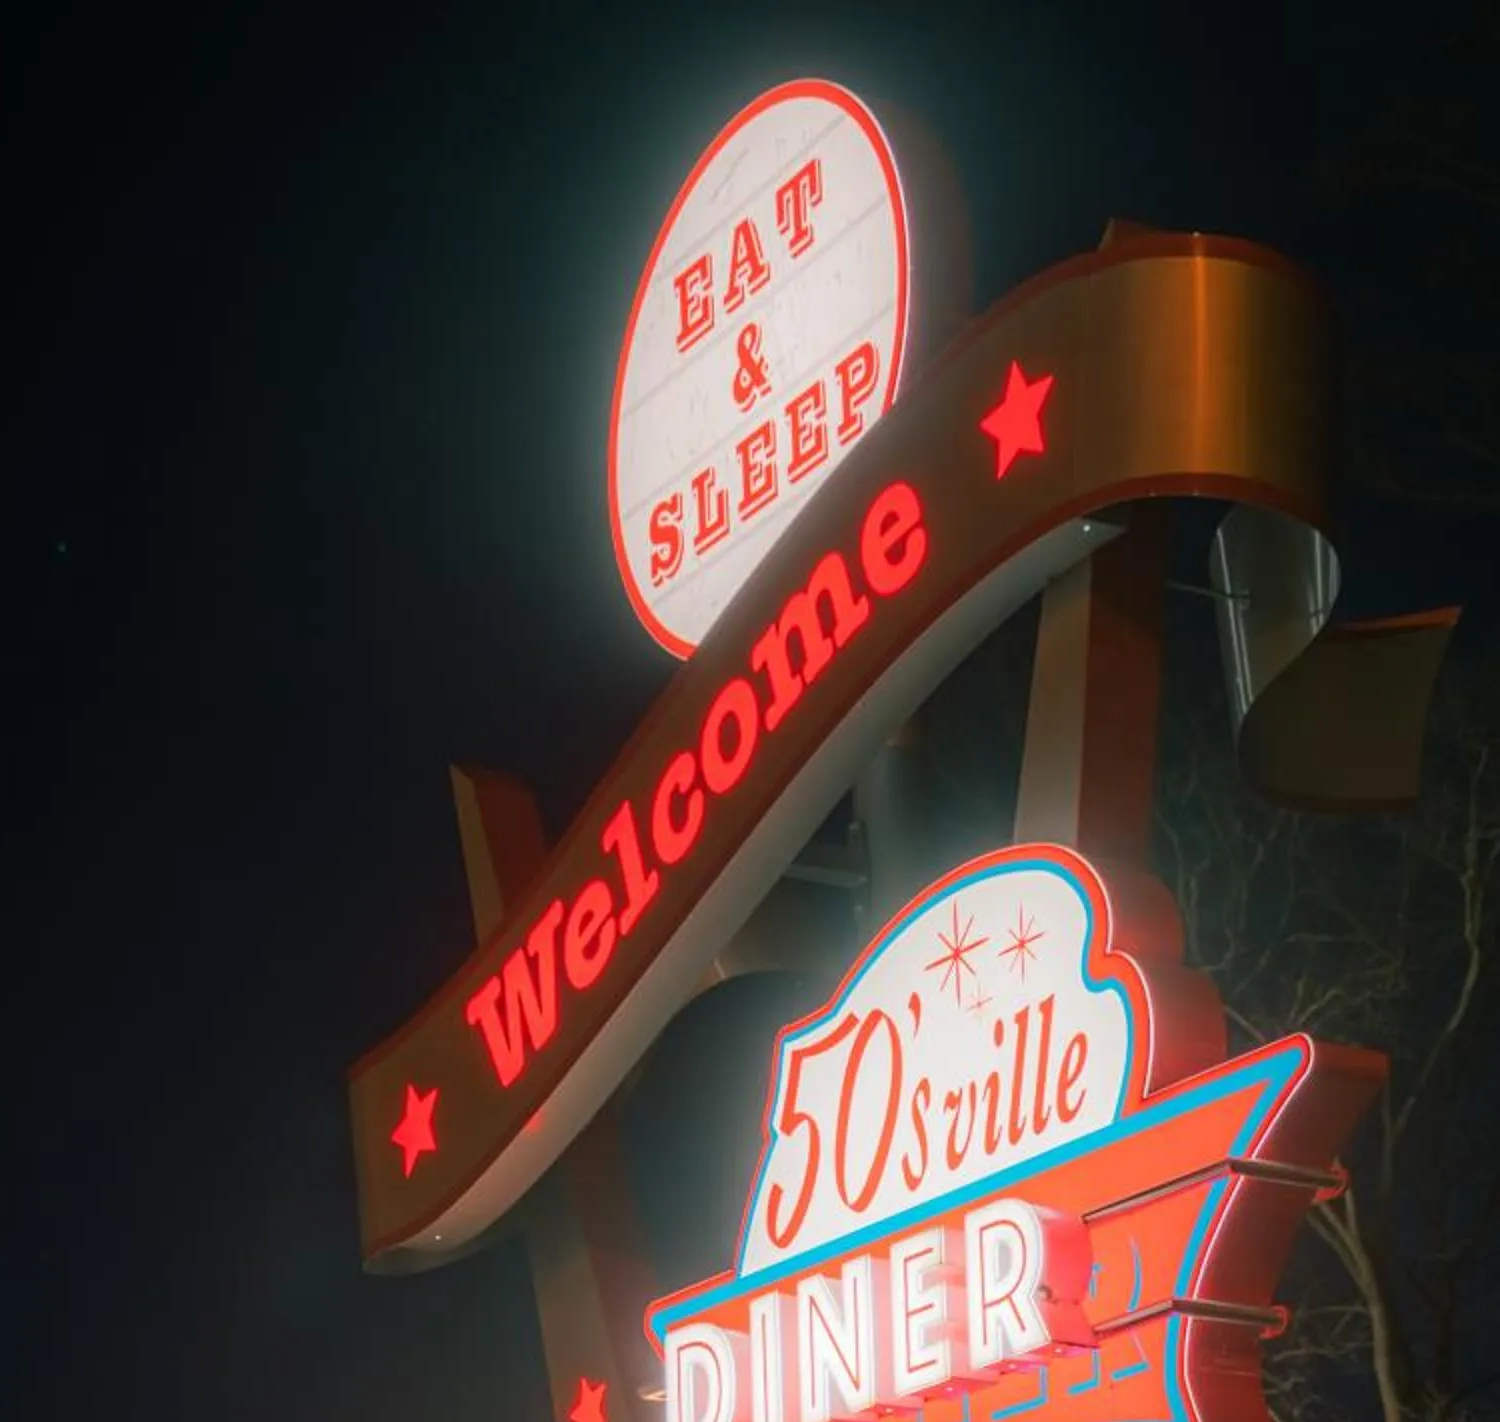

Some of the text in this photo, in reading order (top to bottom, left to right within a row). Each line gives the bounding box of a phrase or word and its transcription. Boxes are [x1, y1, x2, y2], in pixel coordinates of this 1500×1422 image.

[673, 158, 823, 352] EAT
[648, 341, 880, 587] SLEEP
[732, 322, 772, 413] &
[466, 481, 927, 1088] Welcome
